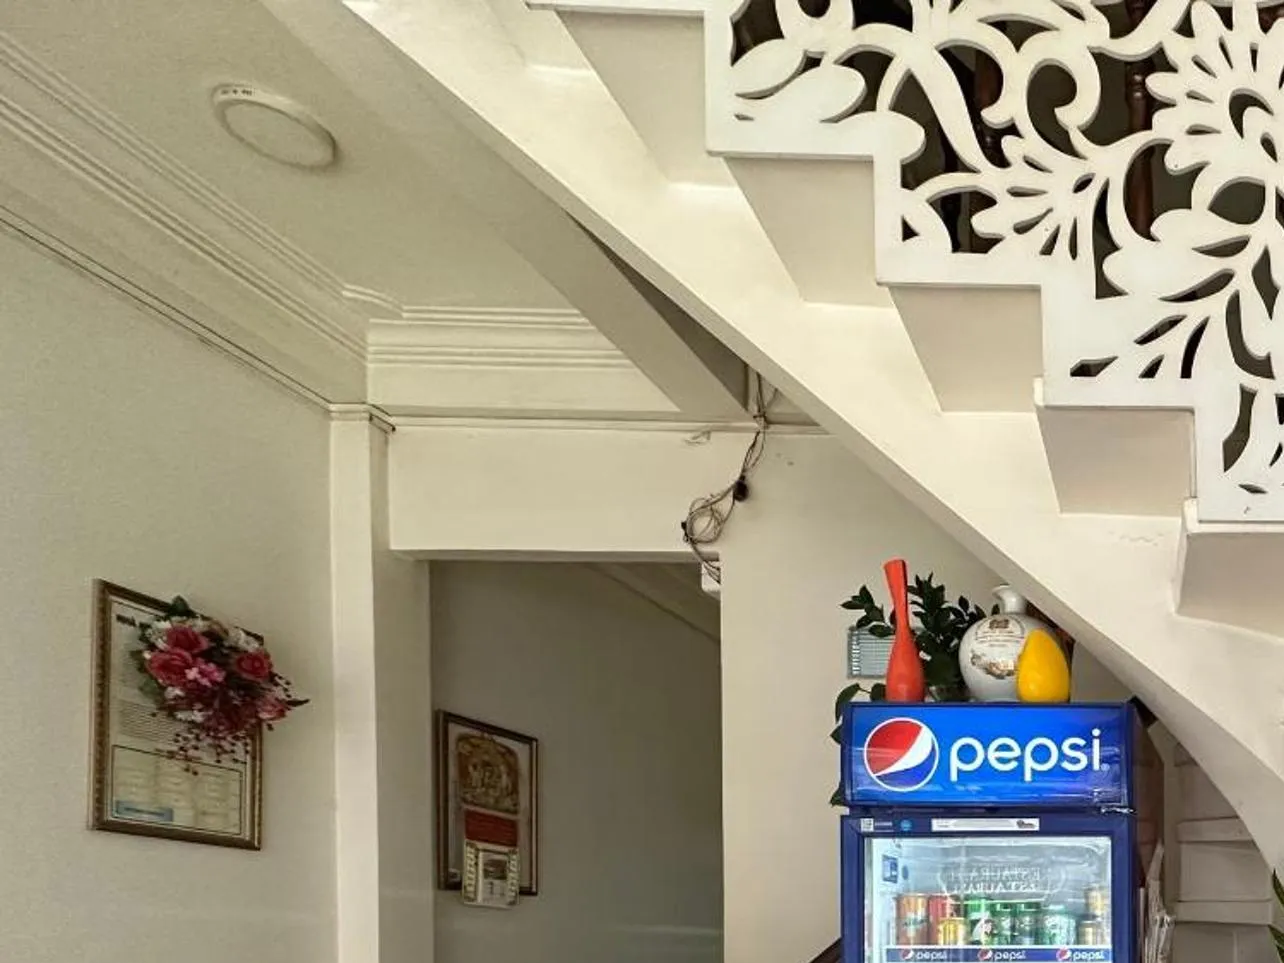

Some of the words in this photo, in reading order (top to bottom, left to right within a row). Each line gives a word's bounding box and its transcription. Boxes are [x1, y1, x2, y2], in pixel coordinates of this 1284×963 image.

[950, 728, 1102, 782] pepsi
[994, 950, 1026, 961] pepsi
[1072, 950, 1105, 962] pepsi
